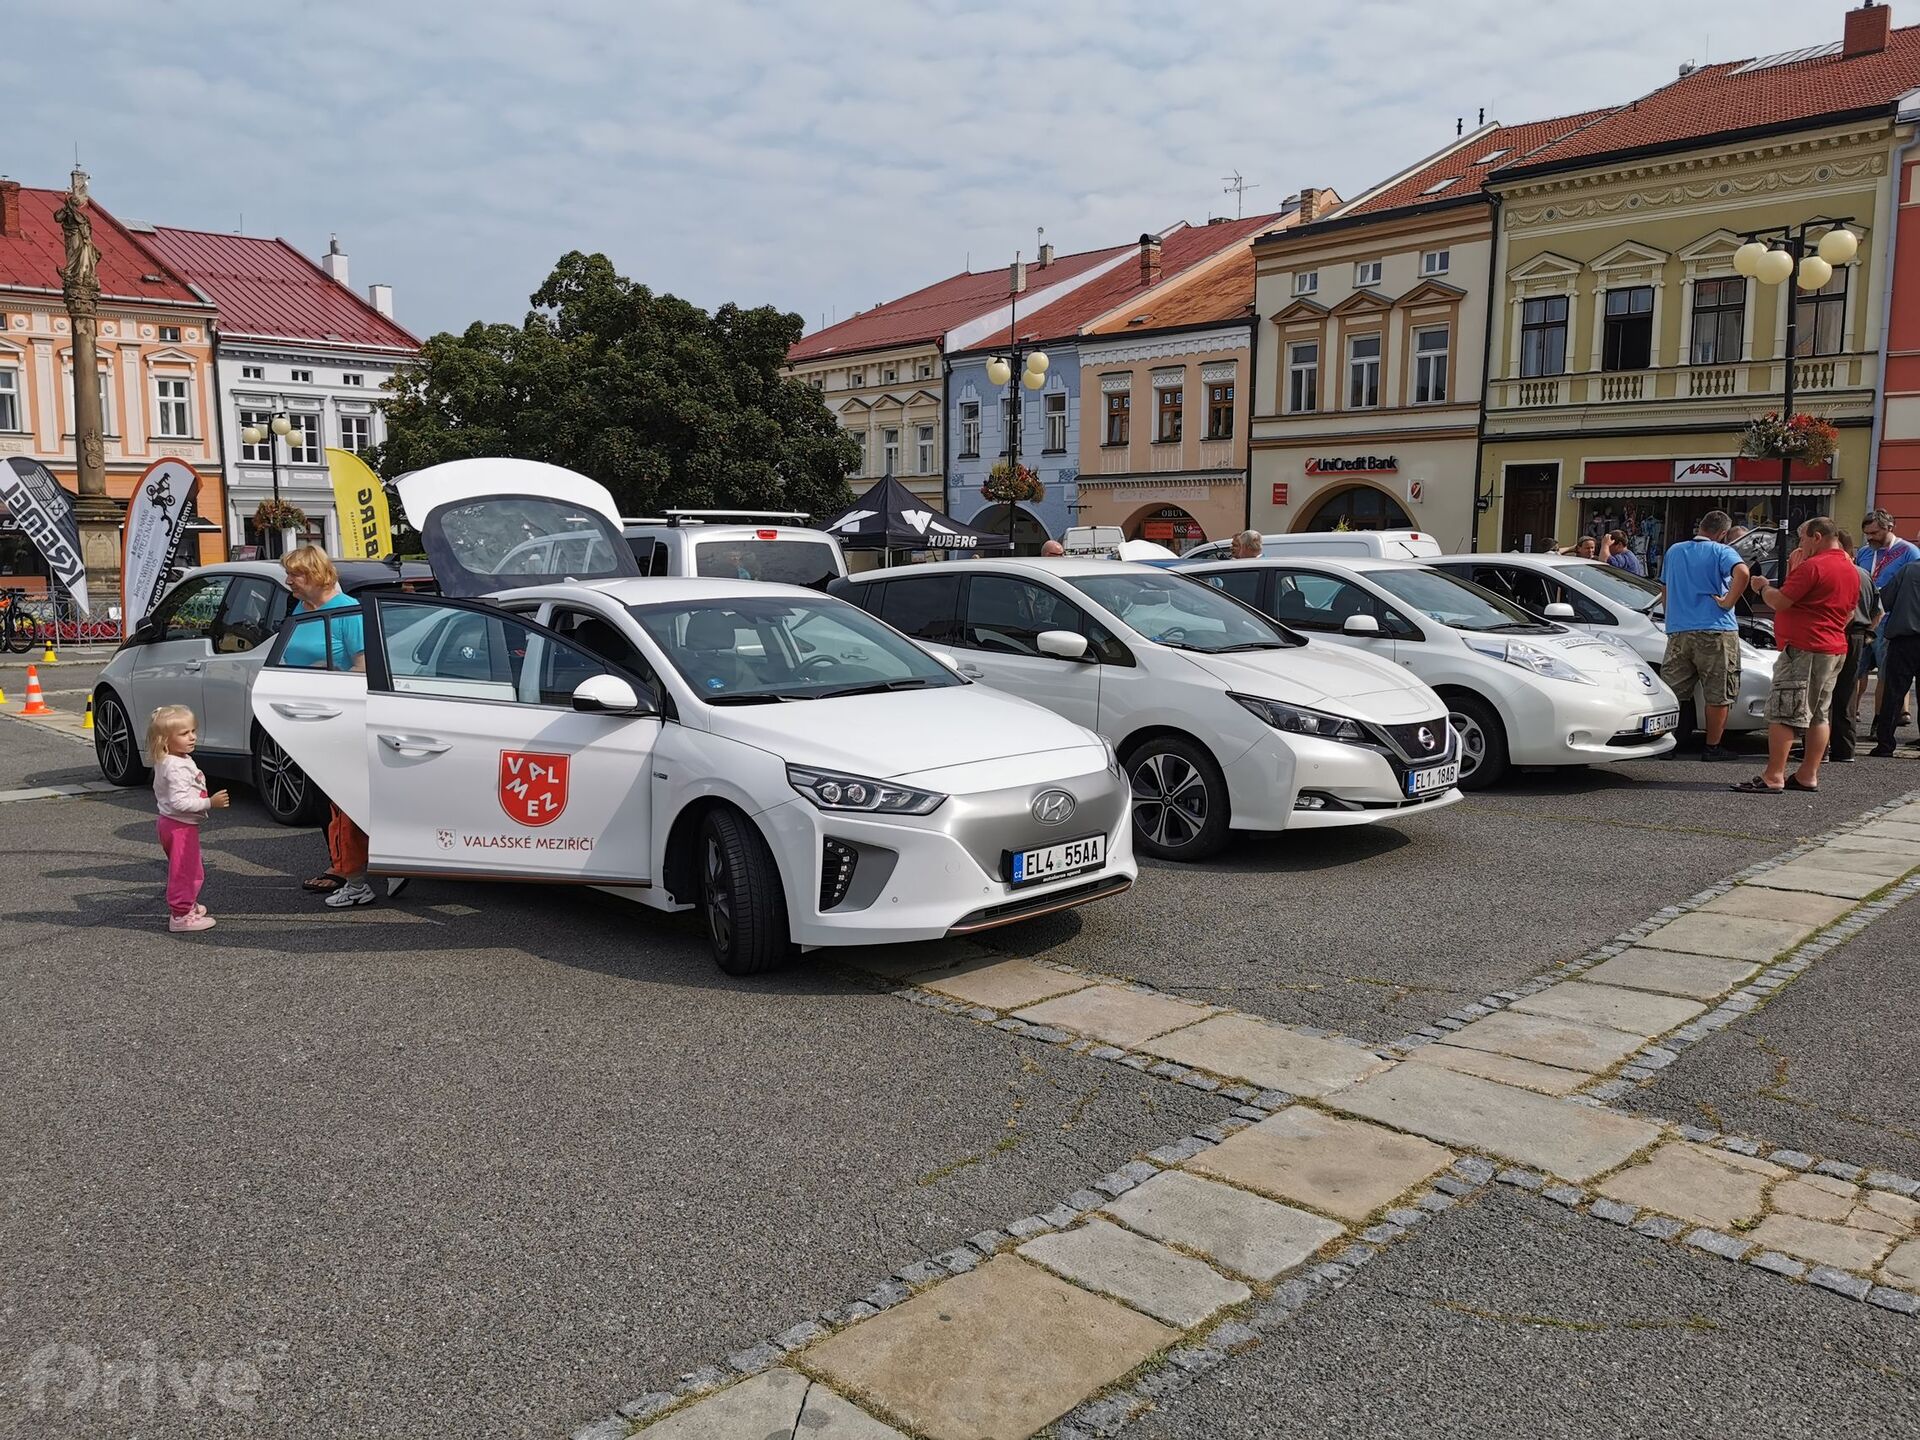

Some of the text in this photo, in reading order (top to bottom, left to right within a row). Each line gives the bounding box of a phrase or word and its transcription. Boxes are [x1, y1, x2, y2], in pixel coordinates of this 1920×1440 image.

[1318, 456, 1398, 471] UniCredit Bank
[927, 535, 978, 548] KUBERG
[153, 580, 165, 605] moto
[160, 546, 176, 579] STYLE
[507, 757, 559, 784] VAL
[1416, 771, 1431, 789] EL1
[463, 834, 595, 851] VALAŠSKÉ MEZIŘÍČÍ
[1026, 850, 1054, 876] EL4
[1065, 840, 1098, 867] 55AA
